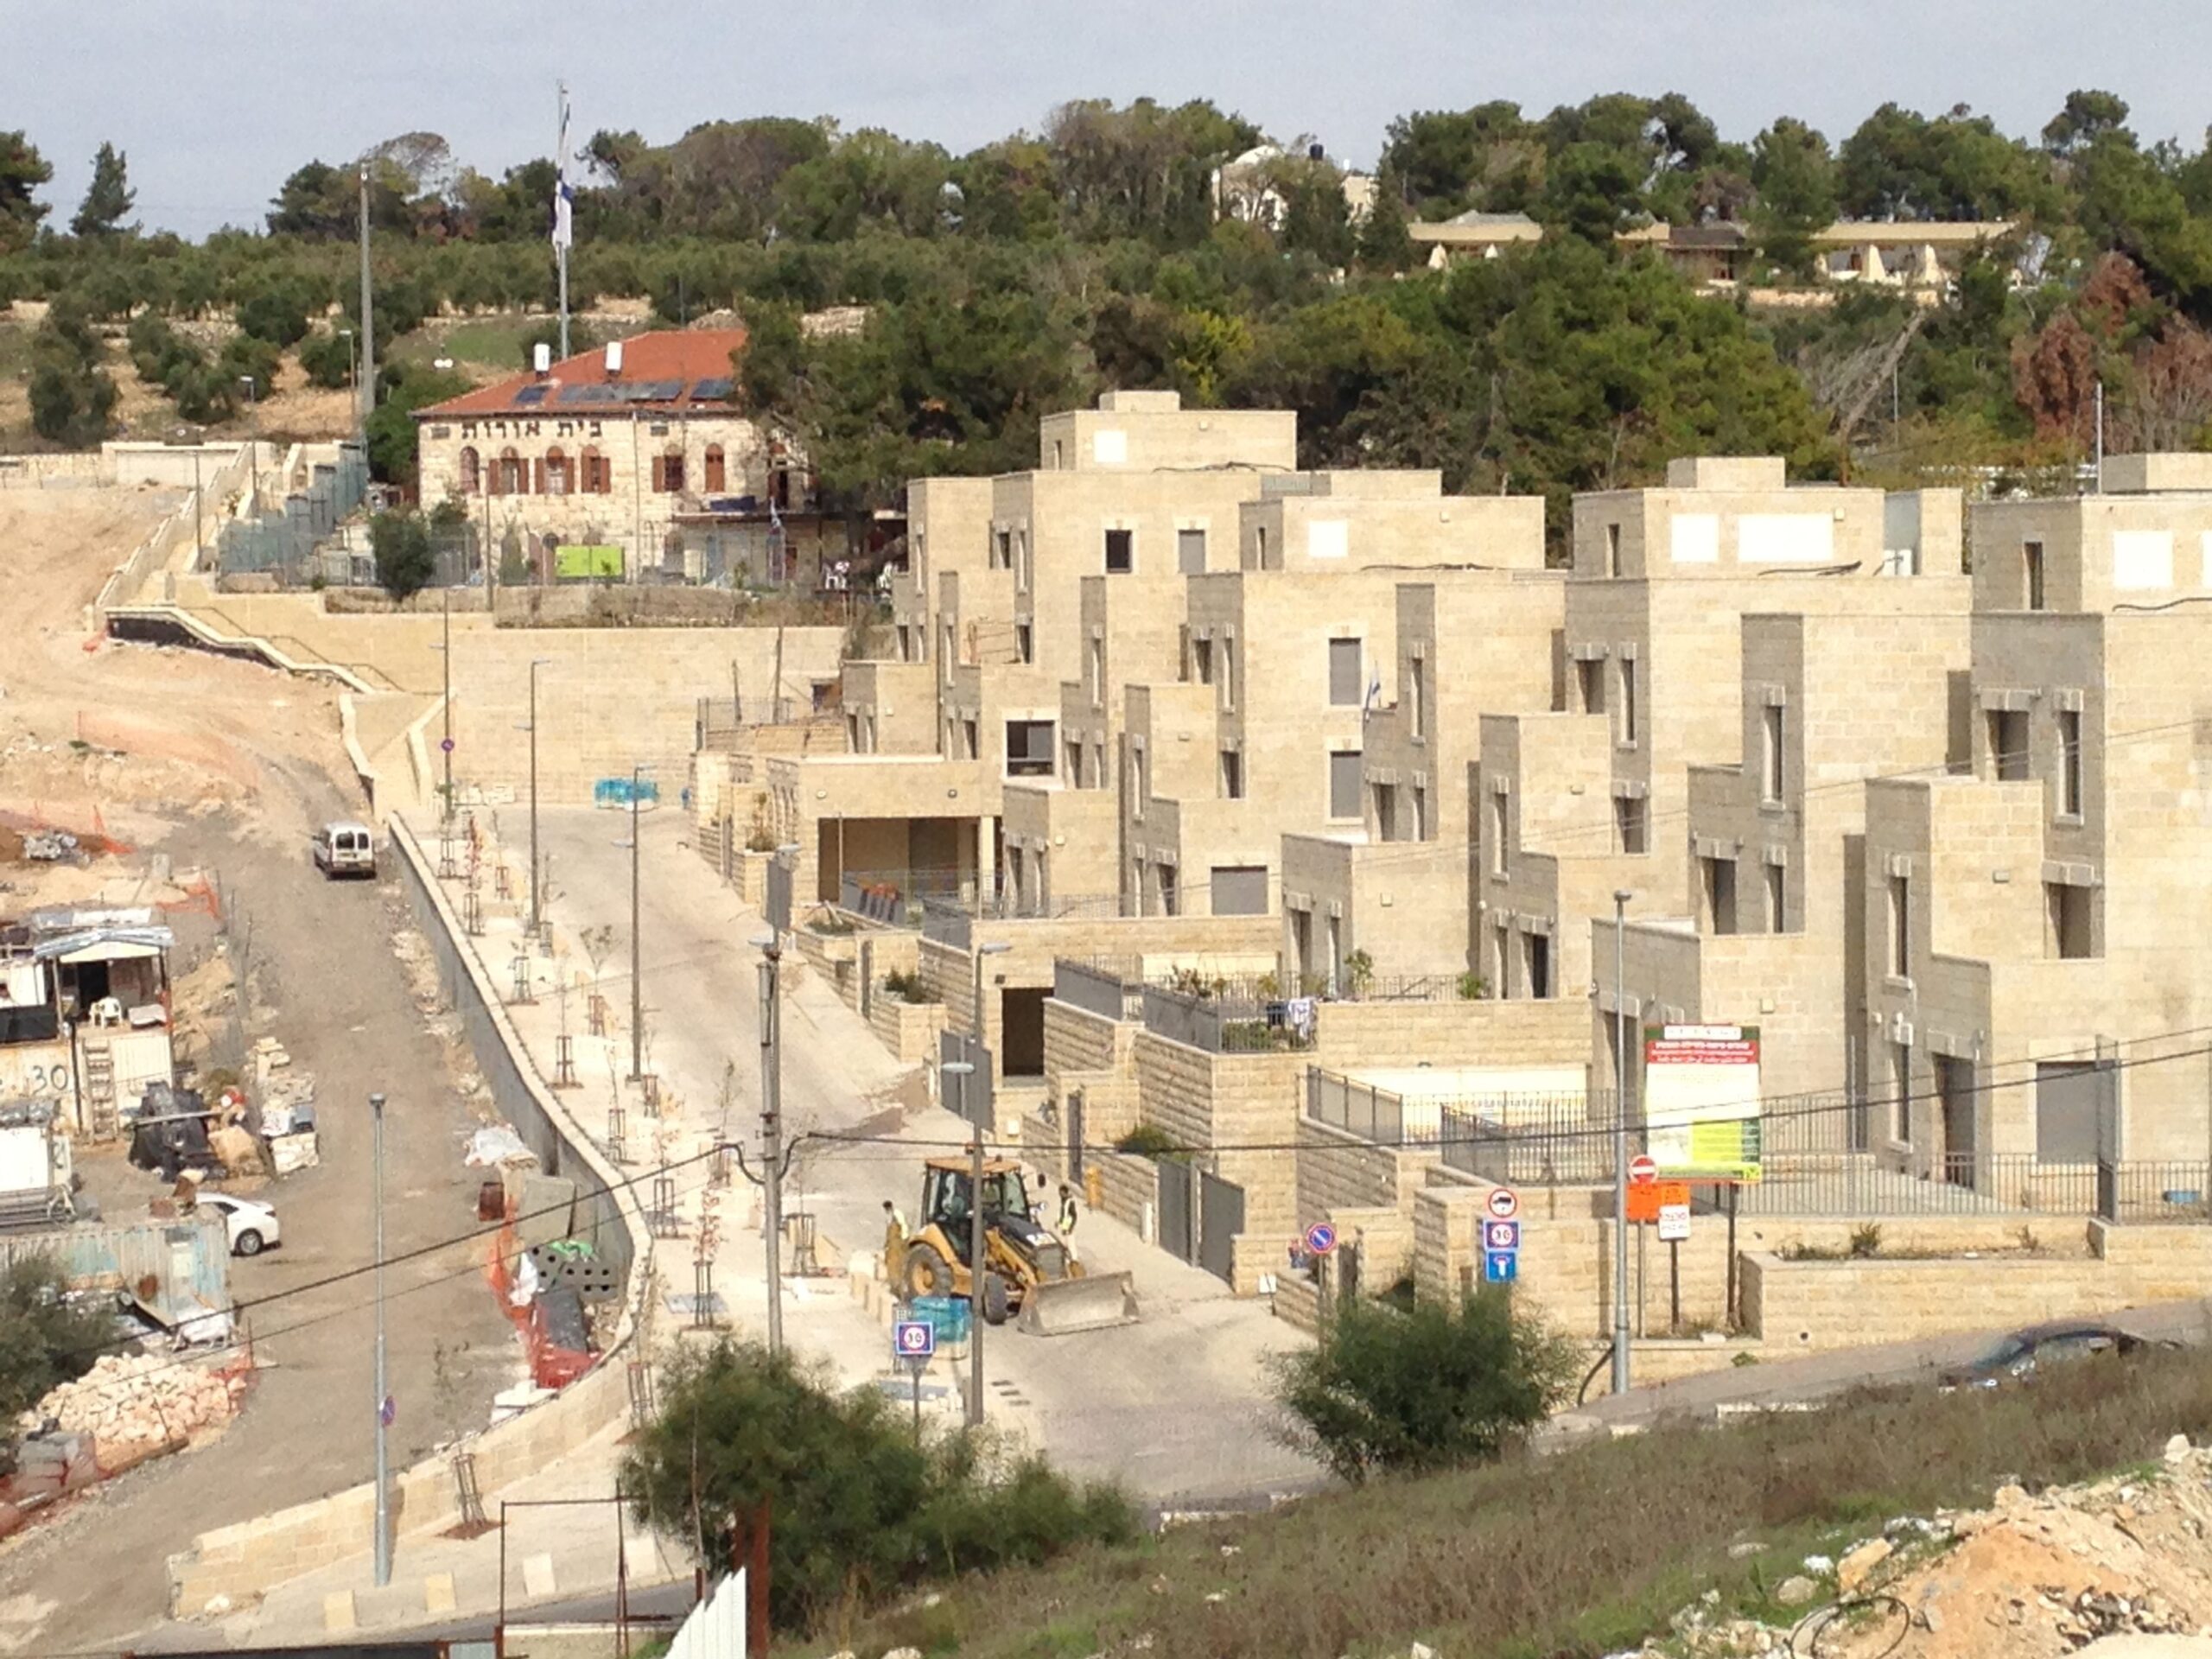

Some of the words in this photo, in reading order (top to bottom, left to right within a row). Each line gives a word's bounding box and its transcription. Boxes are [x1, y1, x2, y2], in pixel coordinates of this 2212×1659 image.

[461, 421, 540, 440] אורות
[557, 419, 602, 438] בית
[32, 1064, 69, 1096] 30
